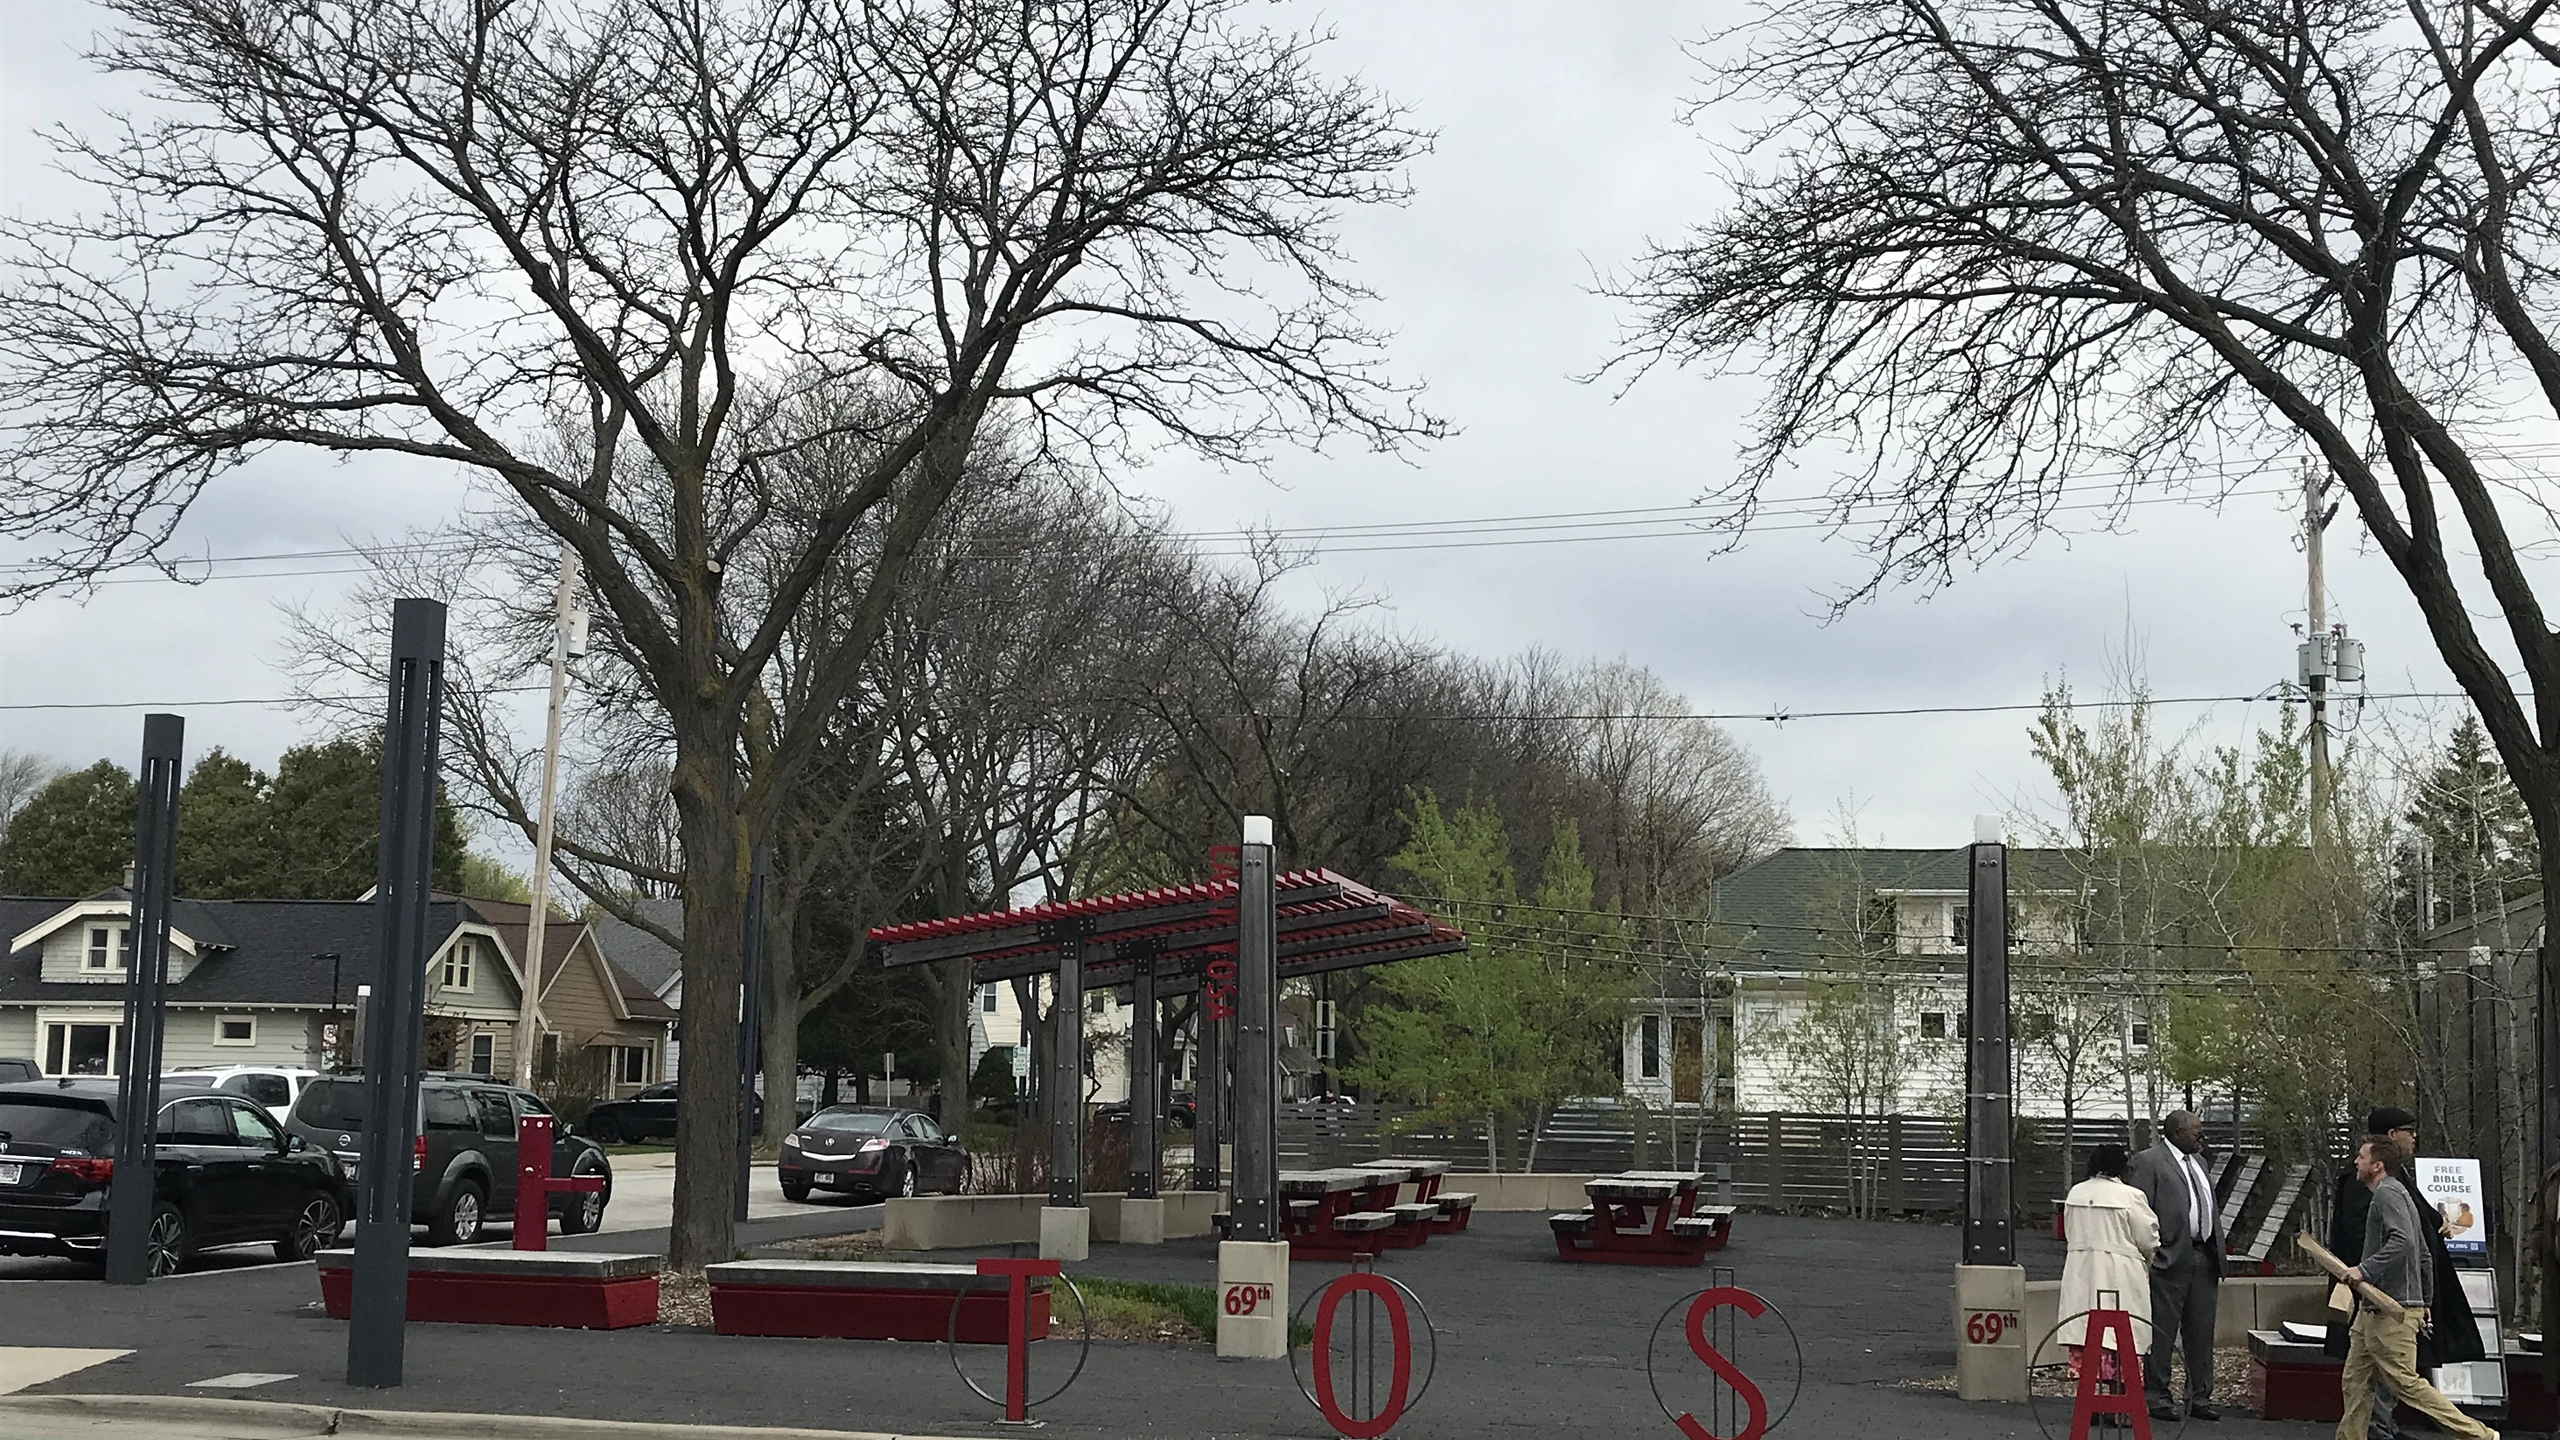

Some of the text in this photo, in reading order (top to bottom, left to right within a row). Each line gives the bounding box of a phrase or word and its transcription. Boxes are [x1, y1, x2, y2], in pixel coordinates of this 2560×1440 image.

[1206, 941, 1238, 1021] TOSA
[2433, 1175, 2465, 1184] BIBLE
[2434, 1166, 2462, 1174] FREE
[2427, 1184, 2472, 1193] COURSE
[1225, 1286, 1270, 1315] 69th
[1967, 1313, 2018, 1344] 69th
